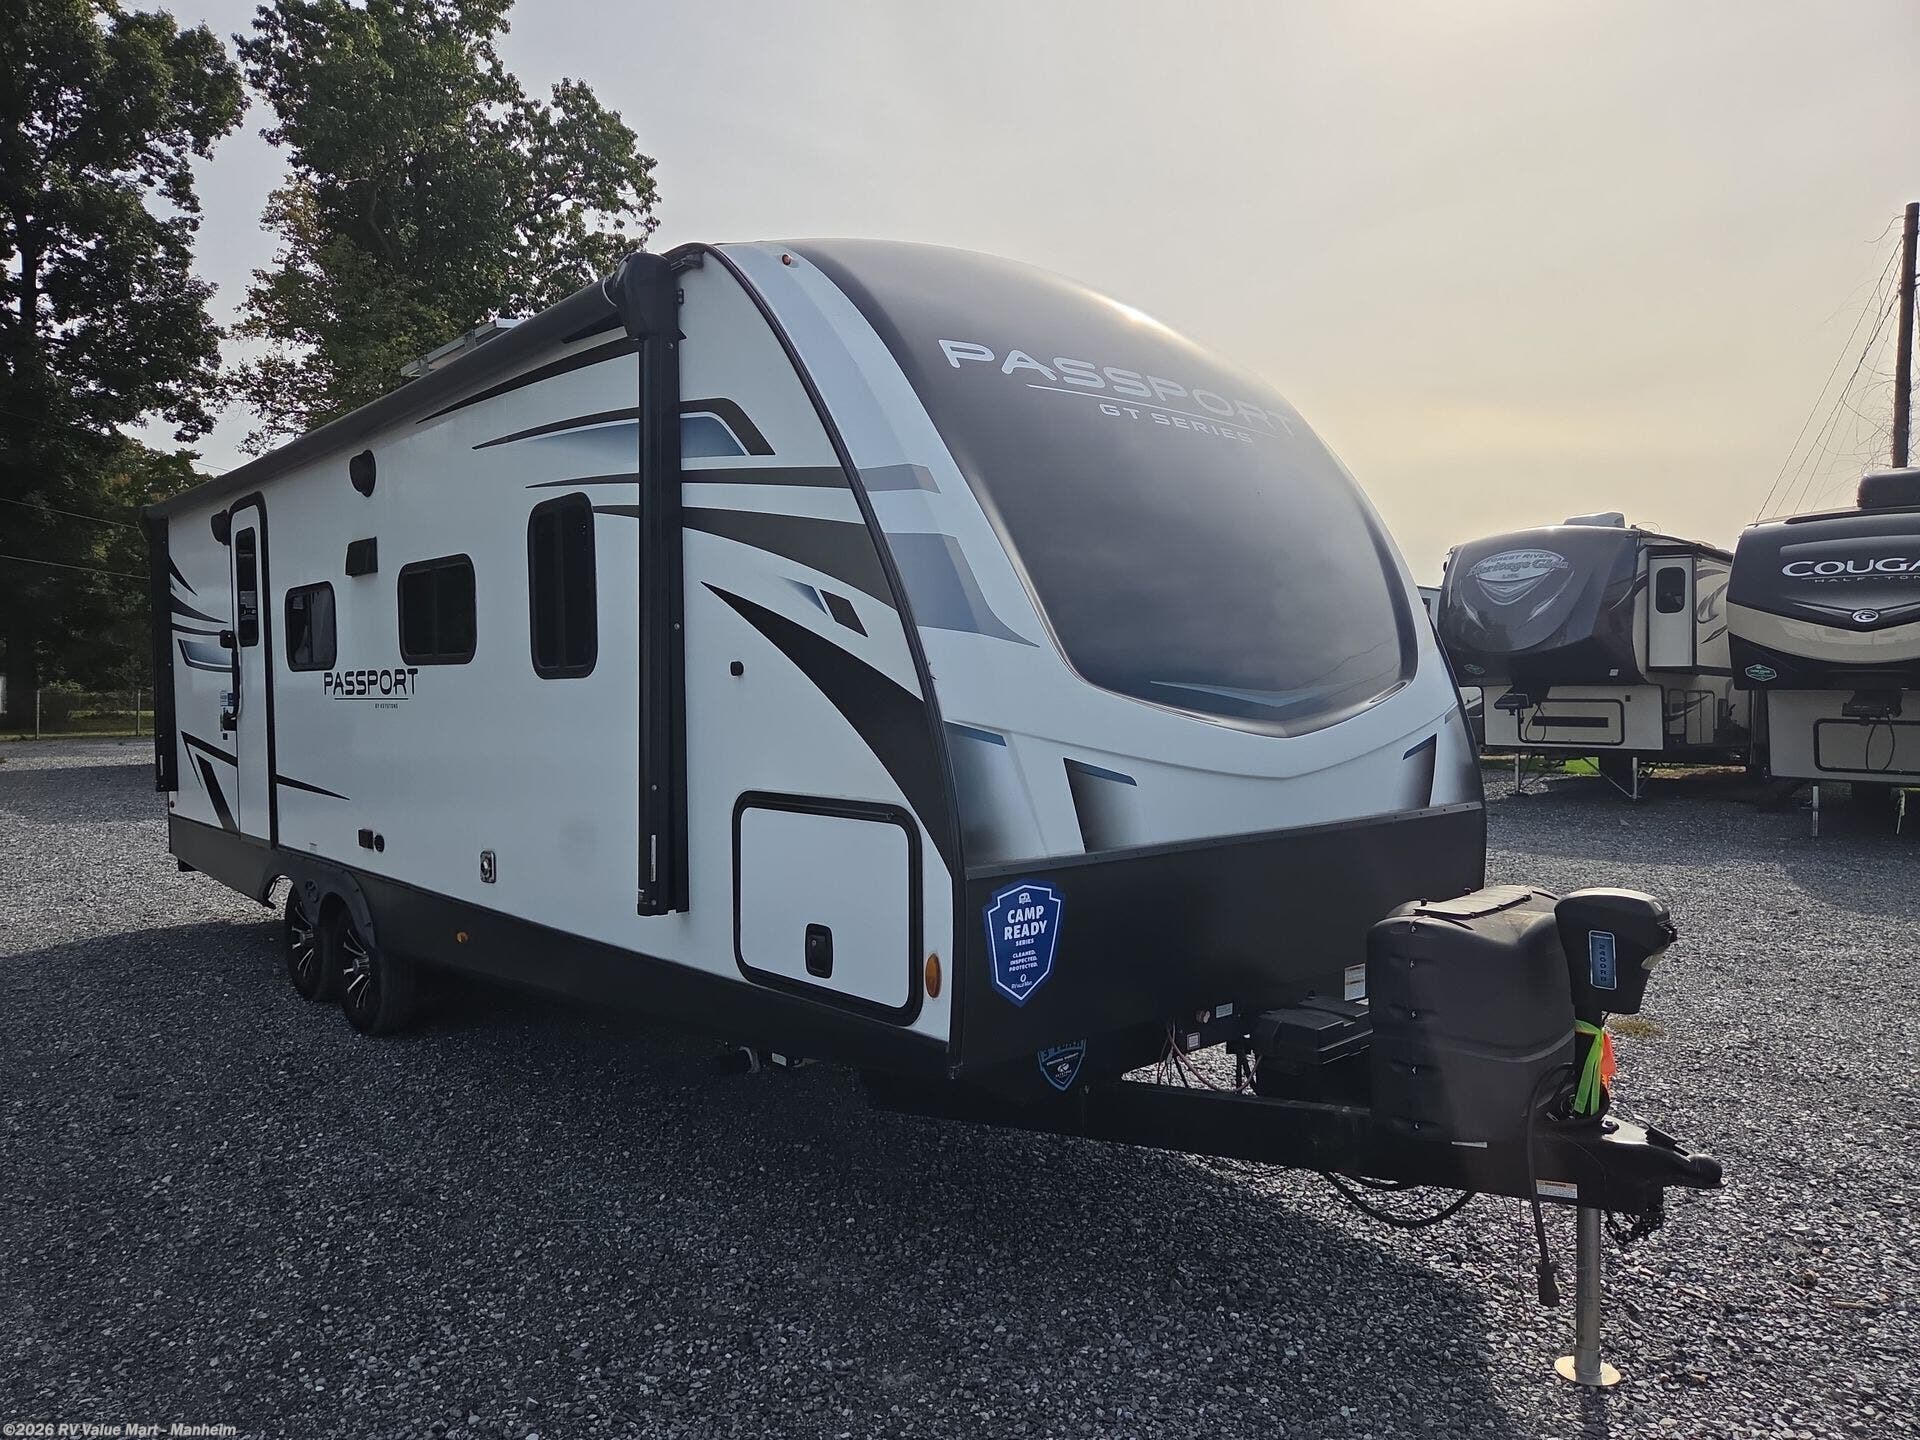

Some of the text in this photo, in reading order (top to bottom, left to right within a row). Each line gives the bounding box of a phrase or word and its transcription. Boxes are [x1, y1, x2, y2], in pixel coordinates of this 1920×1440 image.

[938, 339, 1295, 437] PASSPORT
[1100, 403, 1253, 443] GT SERIES
[323, 668, 419, 695] PASSPORT
[1007, 906, 1044, 923] CAMP
[1004, 920, 1047, 940] READY
